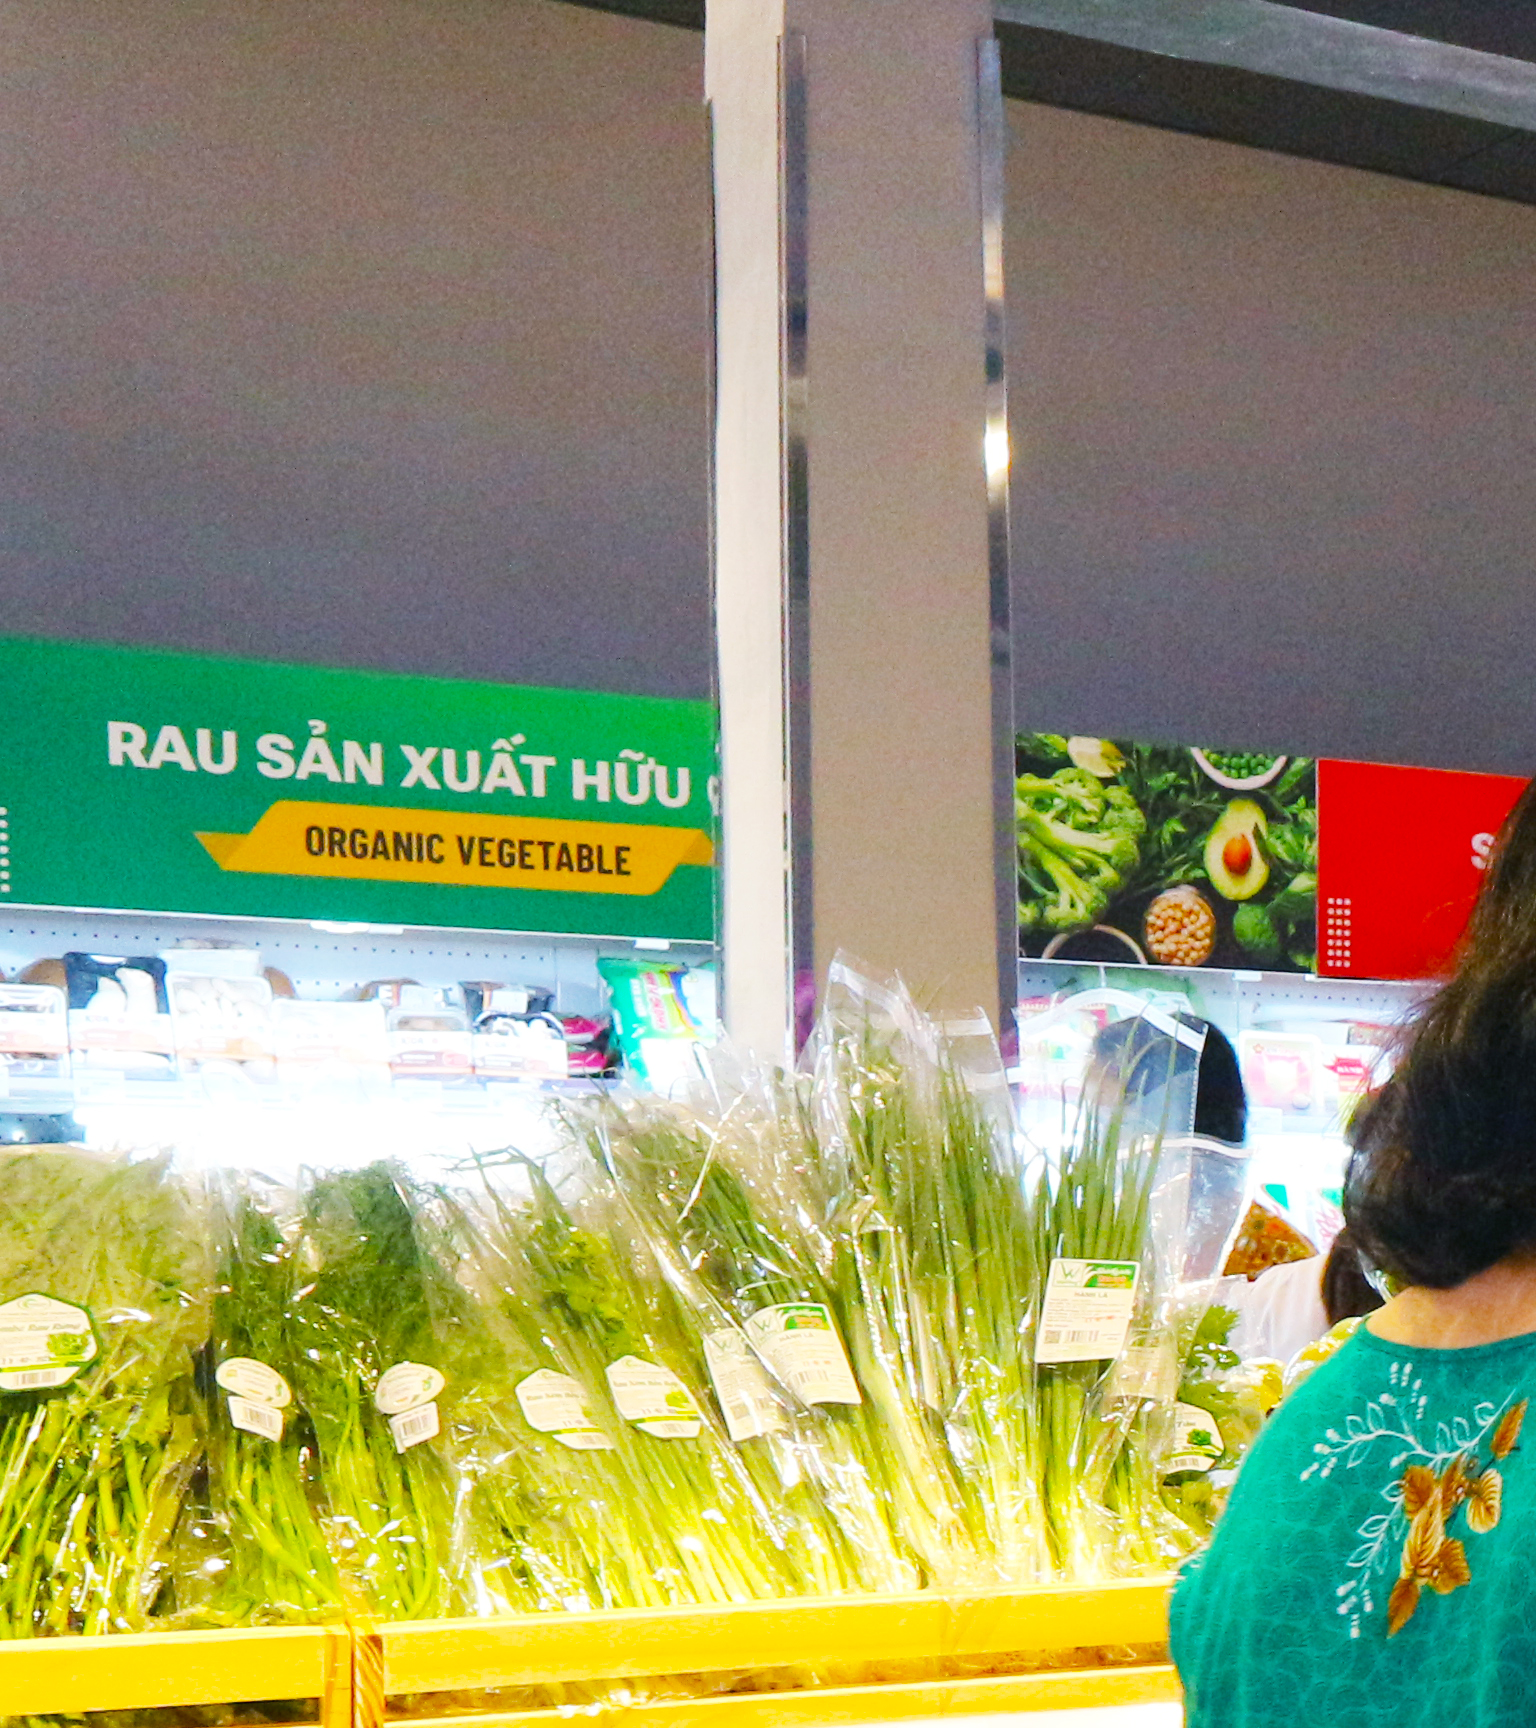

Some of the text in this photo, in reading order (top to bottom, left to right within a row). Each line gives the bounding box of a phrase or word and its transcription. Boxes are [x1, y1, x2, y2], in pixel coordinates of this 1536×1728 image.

[107, 720, 238, 776] RAU
[255, 718, 384, 787] SẢN
[399, 732, 557, 800] XUẤT
[571, 748, 691, 808] HỮU
[304, 824, 632, 877] ORGANIC VEGETABLE
